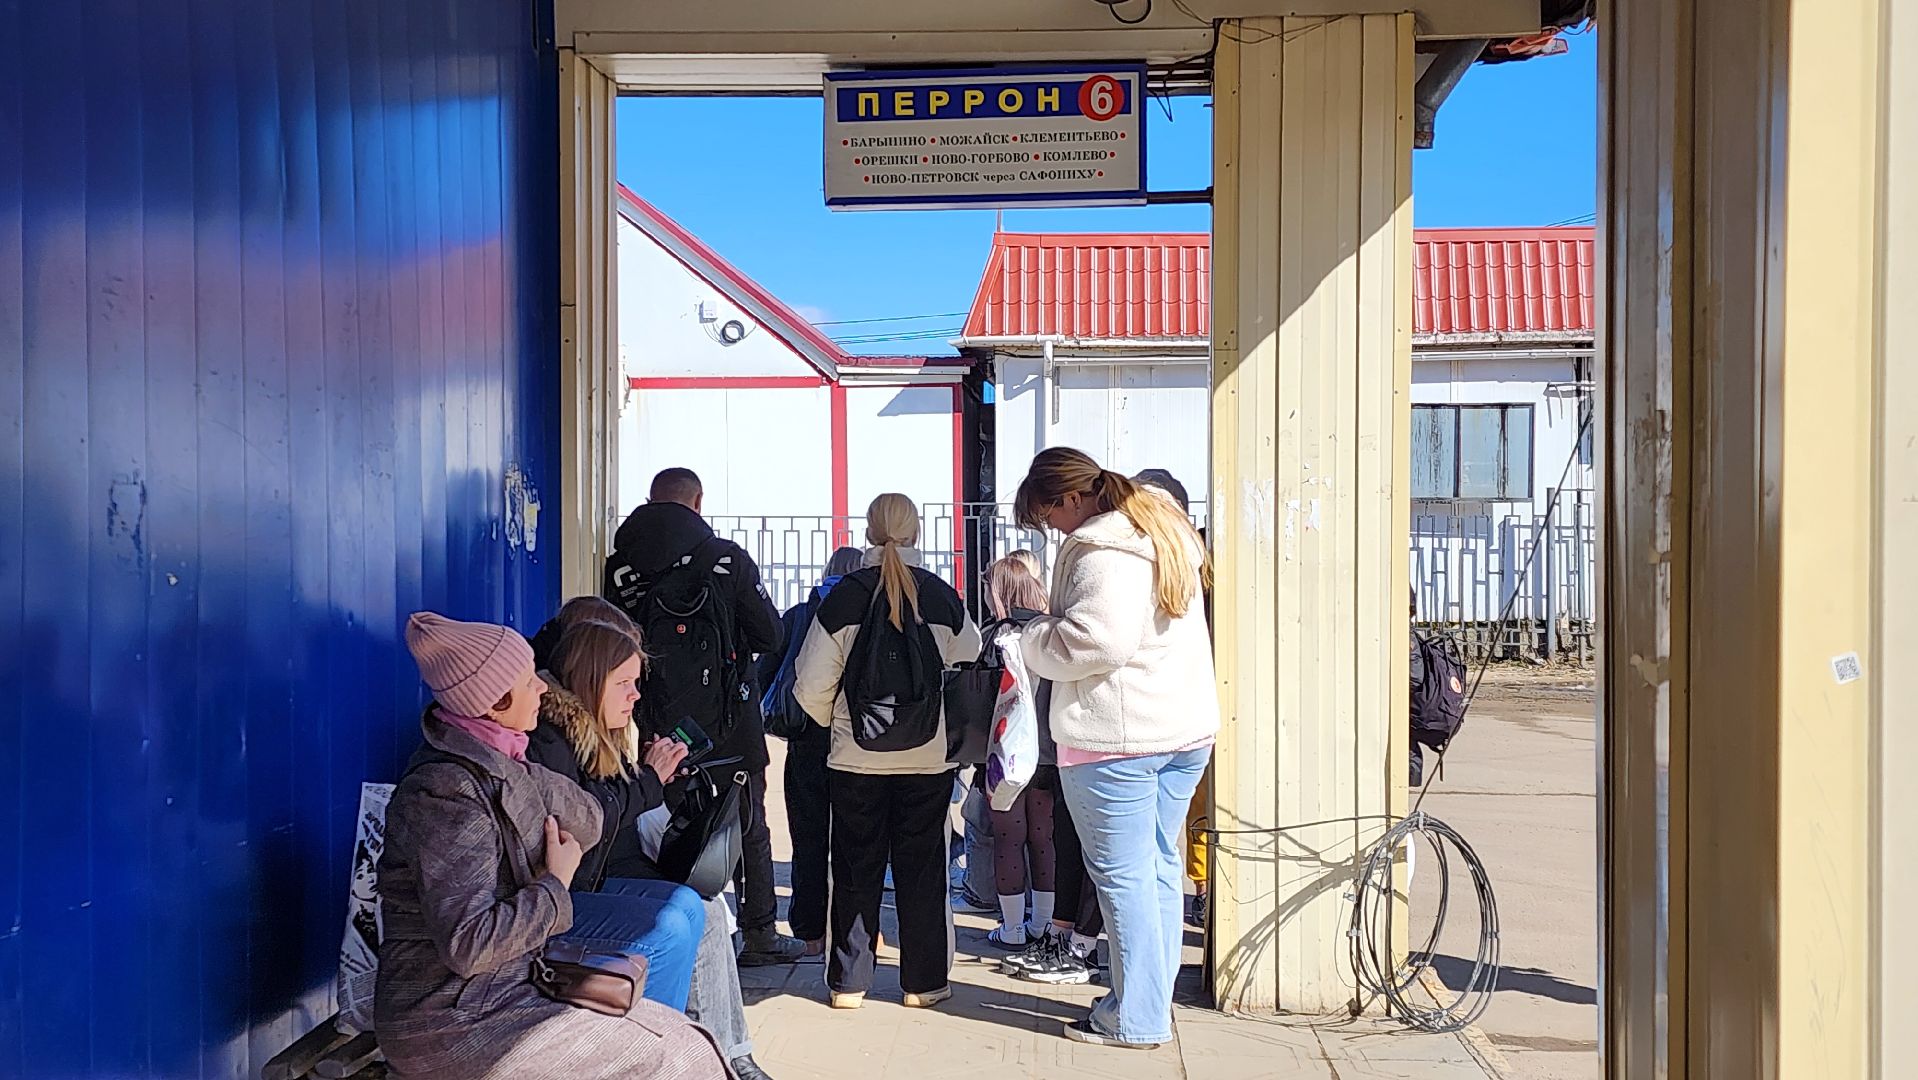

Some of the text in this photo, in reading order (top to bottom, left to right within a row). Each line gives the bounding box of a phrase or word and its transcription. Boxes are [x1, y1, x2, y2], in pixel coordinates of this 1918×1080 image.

[857, 80, 1114, 117] ПЕРРОН 6
[939, 132, 1010, 146] МОЖАЙСК
[1020, 130, 1119, 143] КЛЕМЕНТЬЕВО
[861, 149, 1108, 166] ОРЕШКИ НОВО-ГОРБОВО КОМЛЕВО
[872, 168, 1097, 184] НОВО-ПЕТРОВСК через САФОНИХУ
